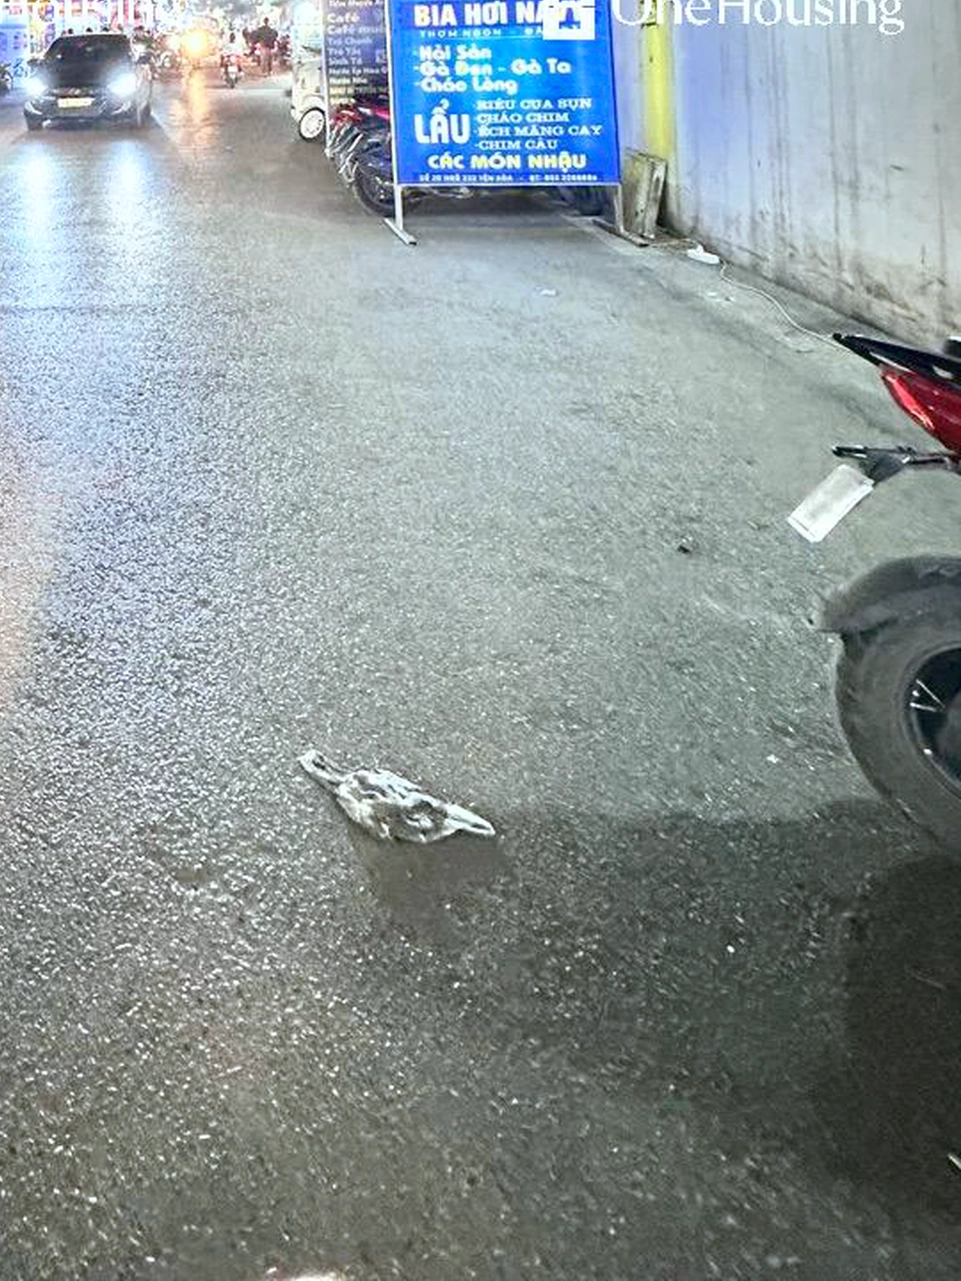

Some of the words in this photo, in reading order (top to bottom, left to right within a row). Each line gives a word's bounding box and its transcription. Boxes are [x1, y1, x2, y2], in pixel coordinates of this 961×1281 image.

[414, 3, 457, 27] BIA
[464, 0, 508, 26] HƠI
[456, 43, 492, 59] Sản
[510, 57, 543, 75] Gà
[546, 57, 572, 74] Ta
[471, 77, 519, 95] Lòng
[519, 99, 553, 110] CUA
[557, 97, 592, 111] SỤN
[414, 98, 471, 144] LẨU
[525, 112, 570, 123] CHIM
[568, 125, 602, 136] CAY
[427, 151, 465, 169] CÁC
[470, 151, 521, 169] MÓN
[527, 150, 587, 173] NHẬU
